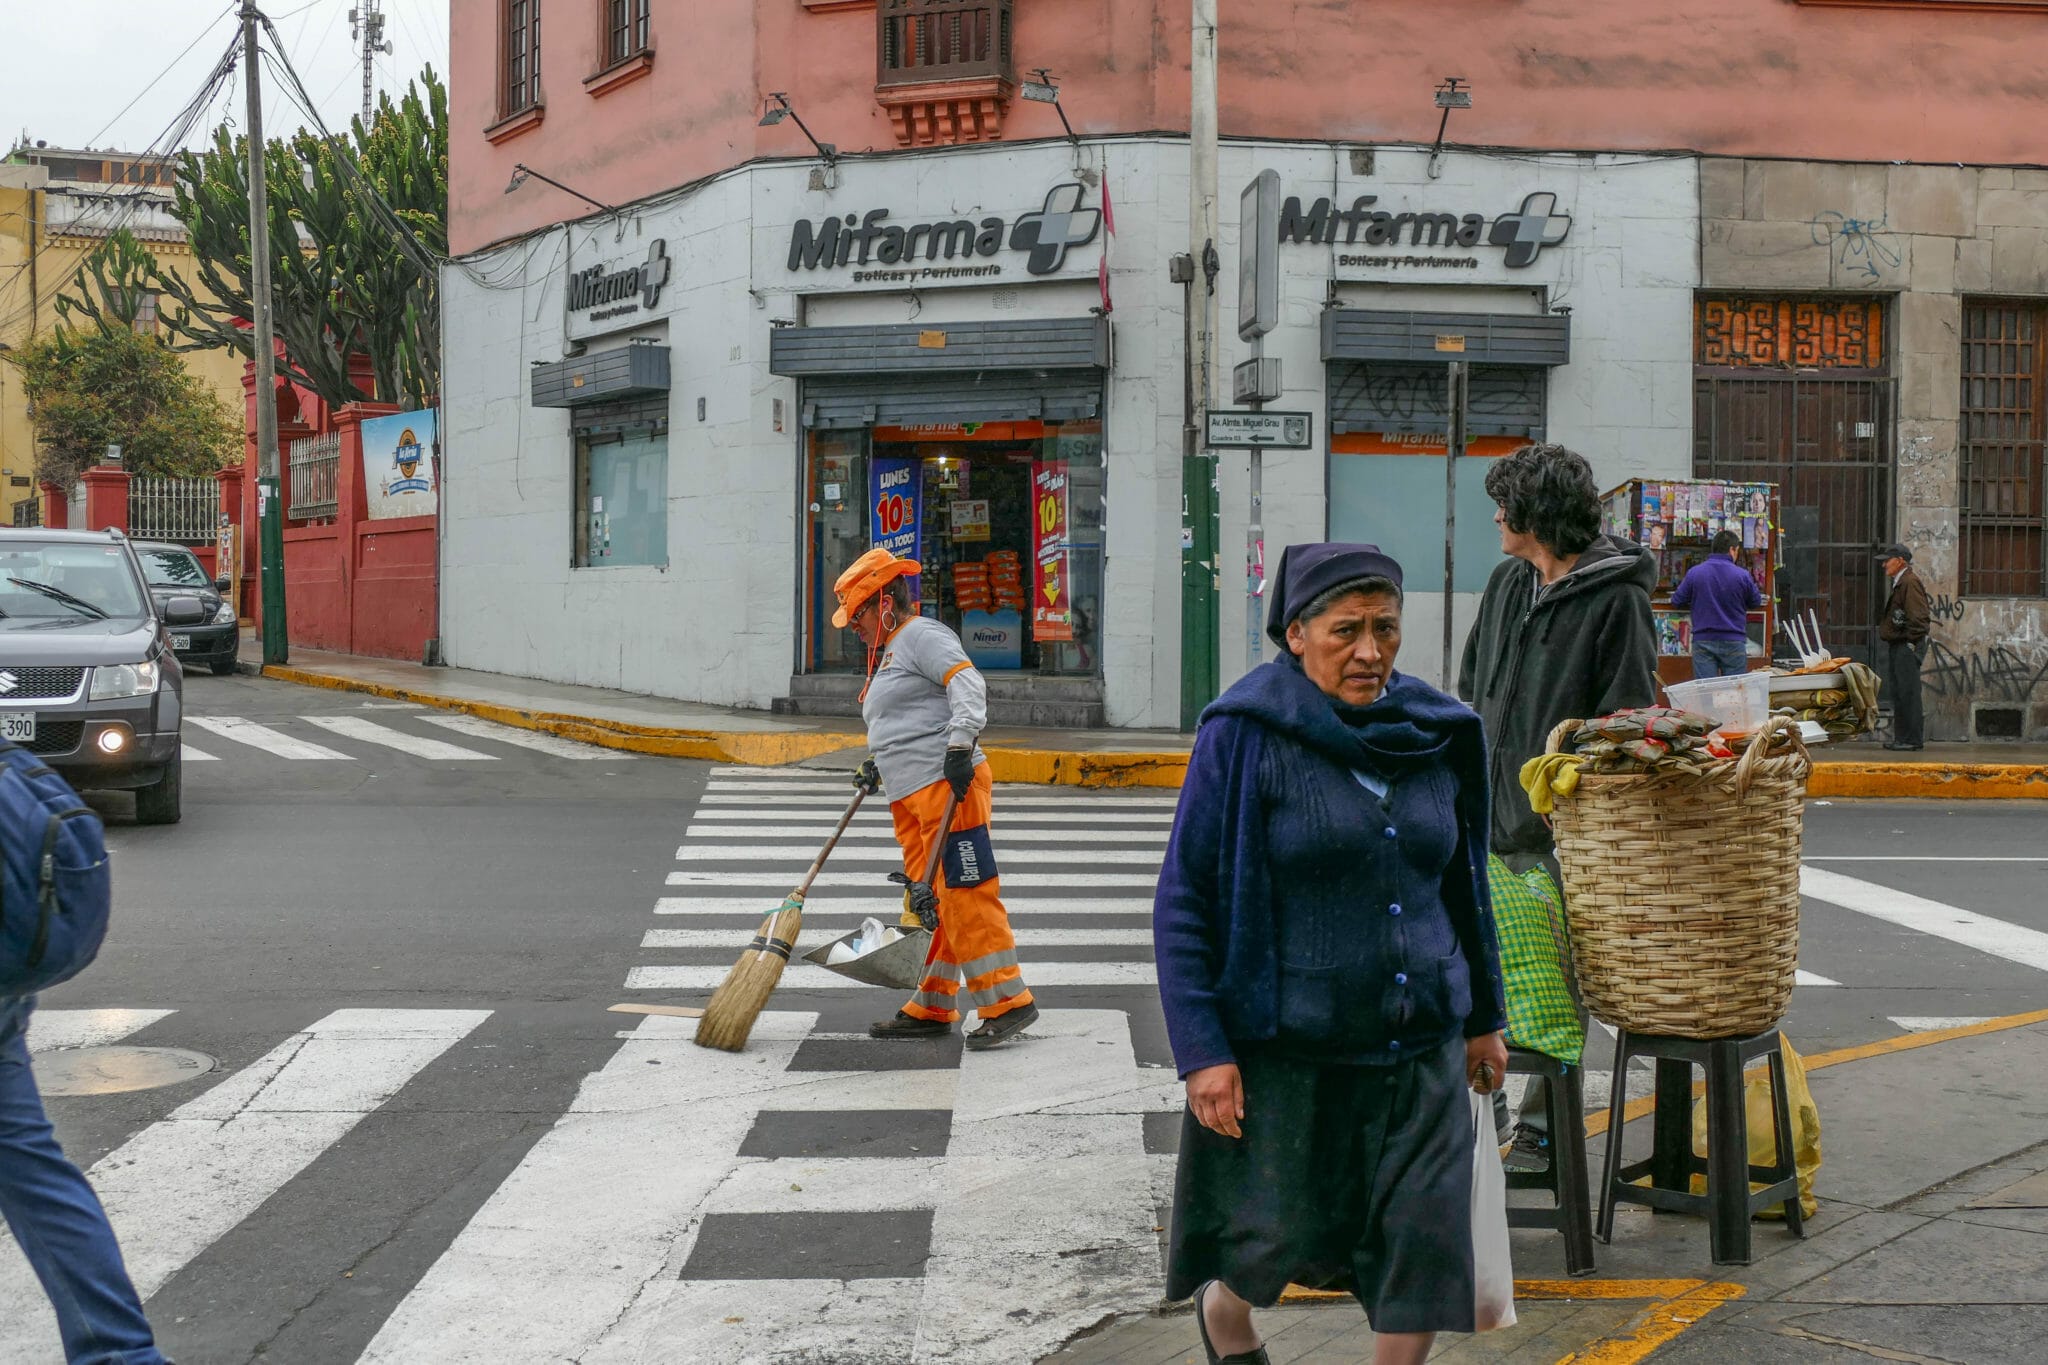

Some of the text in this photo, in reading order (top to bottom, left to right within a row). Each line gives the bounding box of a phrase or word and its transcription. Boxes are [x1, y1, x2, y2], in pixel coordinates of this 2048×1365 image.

[1279, 195, 1484, 247] Mifarma
[787, 208, 1004, 271] Mifarma
[1339, 255, 1388, 267] Boticas
[1393, 257, 1400, 269] y
[853, 264, 1001, 283] Boticas y Perfumería
[568, 264, 638, 312] Mifarma
[1243, 418, 1263, 429] Miguel
[1264, 418, 1280, 427] Grau
[879, 467, 910, 490] LUNES
[894, 531, 915, 548] TODOS
[973, 632, 1002, 642] Ninet
[958, 840, 981, 882] Barranco
